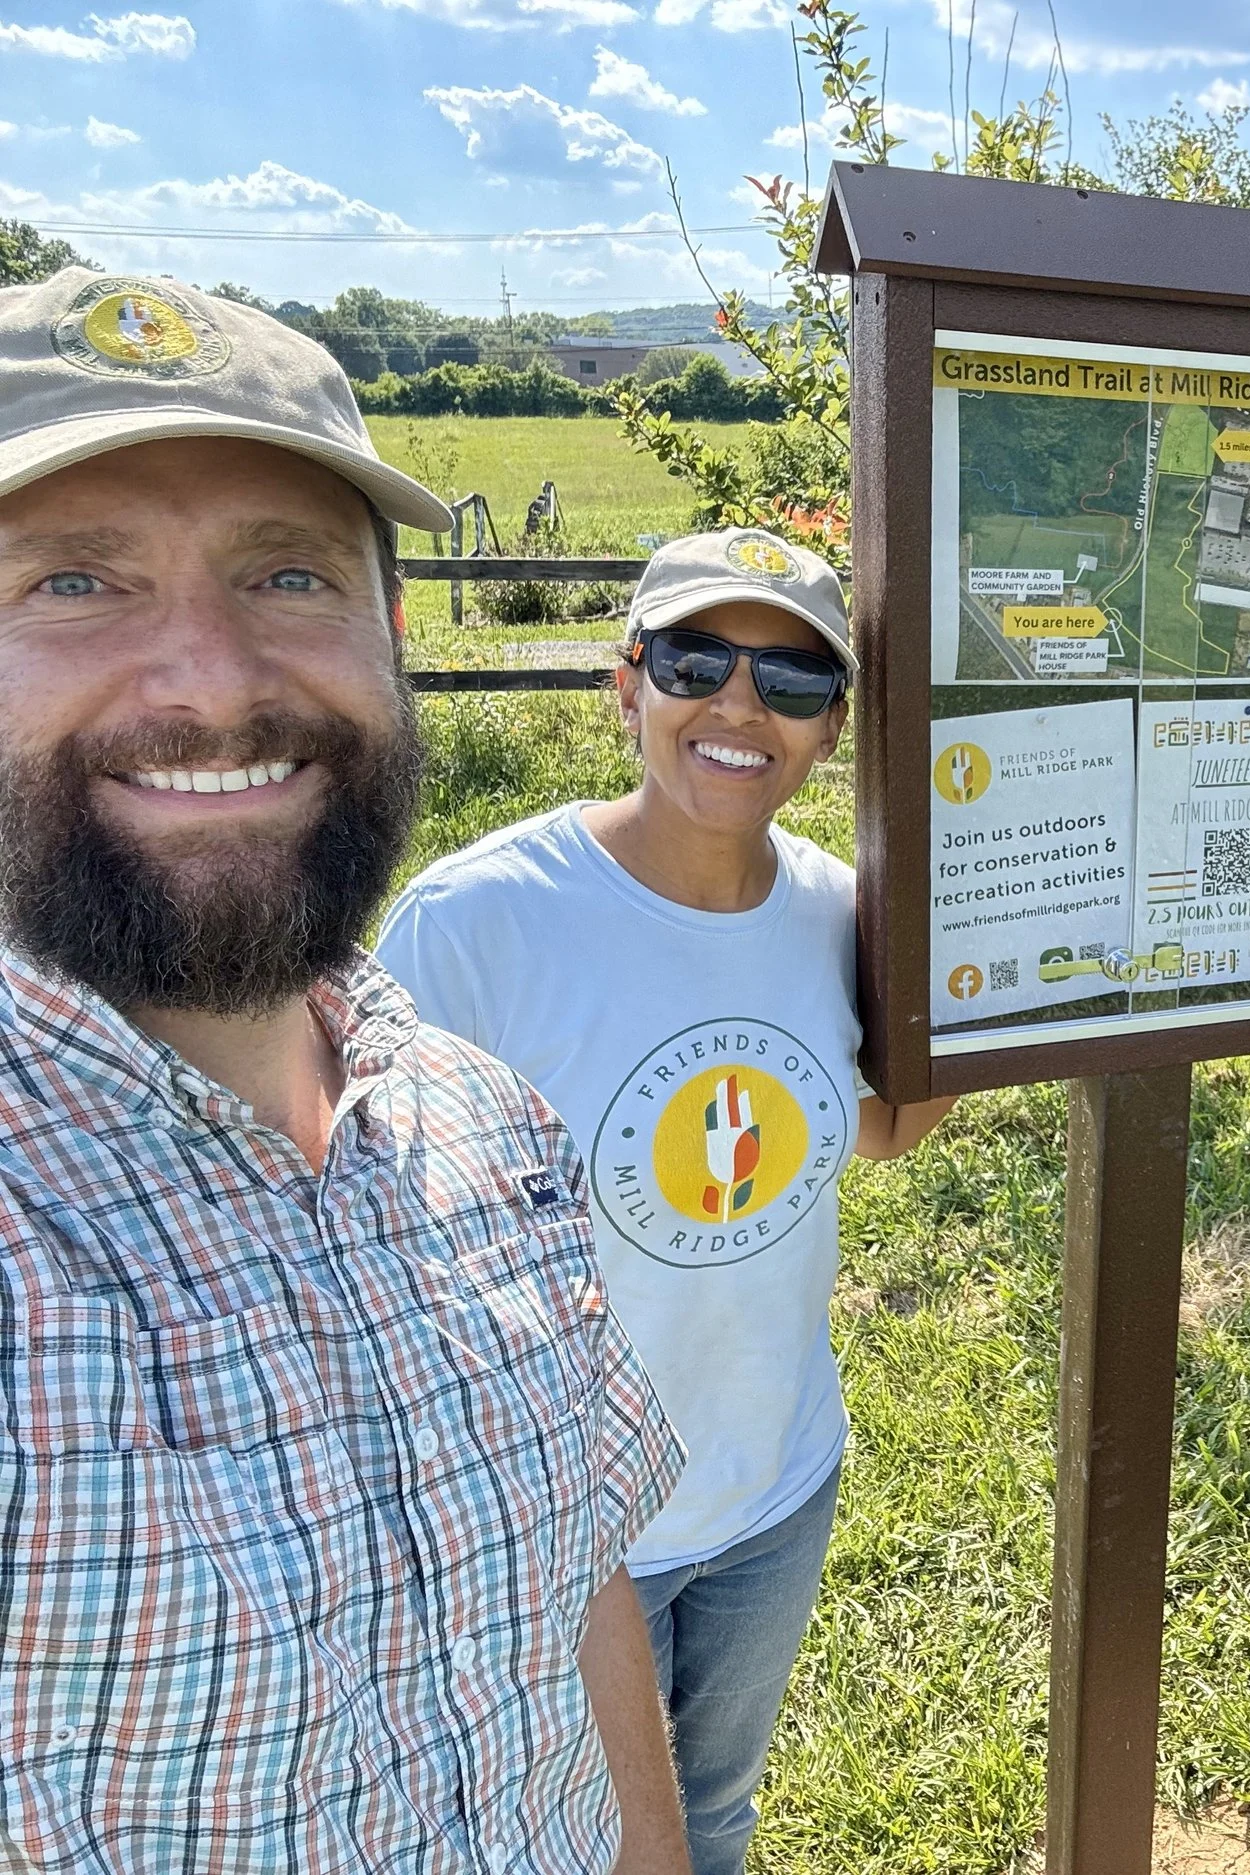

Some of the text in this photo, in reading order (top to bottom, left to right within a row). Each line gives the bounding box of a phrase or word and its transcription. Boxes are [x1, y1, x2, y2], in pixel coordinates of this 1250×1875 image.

[941, 354, 1070, 388] Grassland
[1077, 365, 1133, 392] Trail
[1139, 373, 1163, 394] at
[1171, 372, 1212, 397] Mill
[1220, 442, 1231, 451] 1.5
[1134, 509, 1145, 530] Old
[1149, 417, 1164, 449] Blvd.
[971, 571, 1052, 580] MOORE FARM AND
[971, 582, 1061, 591] COMMUNITY GARDEN
[1014, 616, 1095, 628] You are here
[1060, 652, 1084, 660] RIDGE
[1000, 748, 1076, 765] FRIENDS OF
[1001, 756, 1114, 780] MILL RIDGE PARK
[1171, 803, 1188, 825] AT
[1190, 800, 1219, 824] MILL
[942, 814, 1106, 849] Join us outdoors
[939, 837, 1117, 879] for conservation &
[934, 865, 1125, 908] recreation activities
[942, 894, 1121, 932] www.friendsofmillridgepark.org
[1147, 906, 1172, 925] 2.5
[1177, 901, 1223, 924] HOURS
[637, 1034, 814, 1101] FRIENDS OF
[614, 1133, 837, 1252] MILL RIDGE PARK
